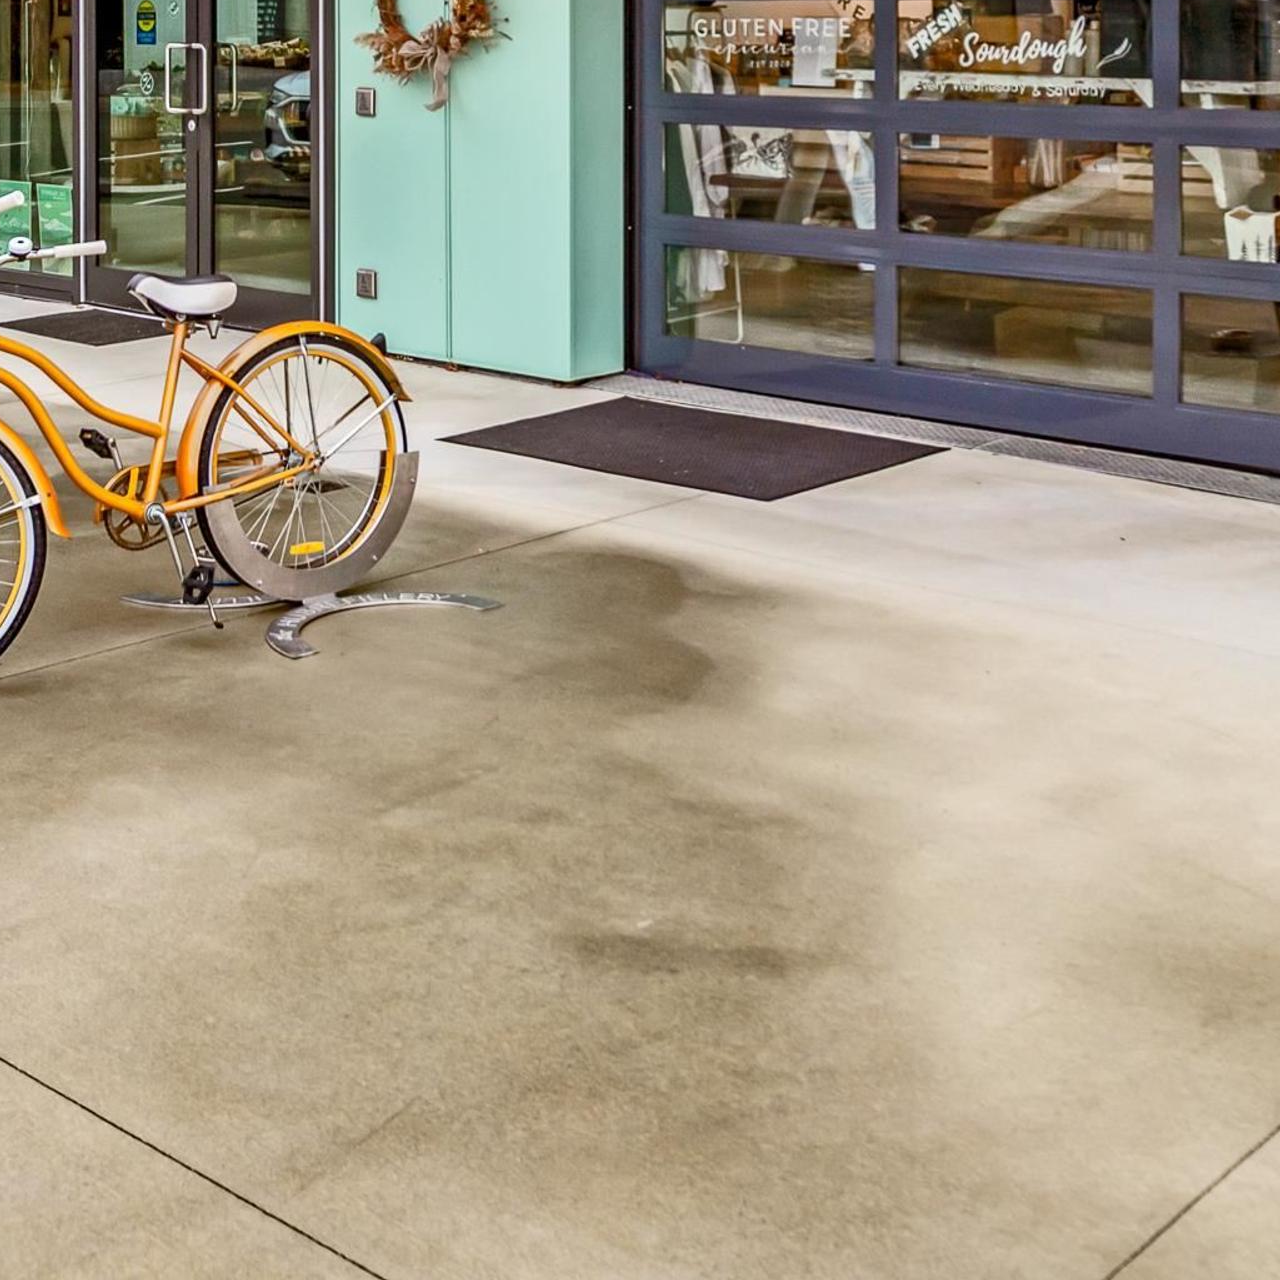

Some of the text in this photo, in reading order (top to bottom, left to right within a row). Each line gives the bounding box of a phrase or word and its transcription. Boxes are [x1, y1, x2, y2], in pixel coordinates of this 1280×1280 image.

[693, 17, 852, 38] GLUTEN FREE
[906, 0, 964, 59] FRESH
[959, 16, 1088, 74] Sourdough
[1047, 83, 1107, 99] Saturday
